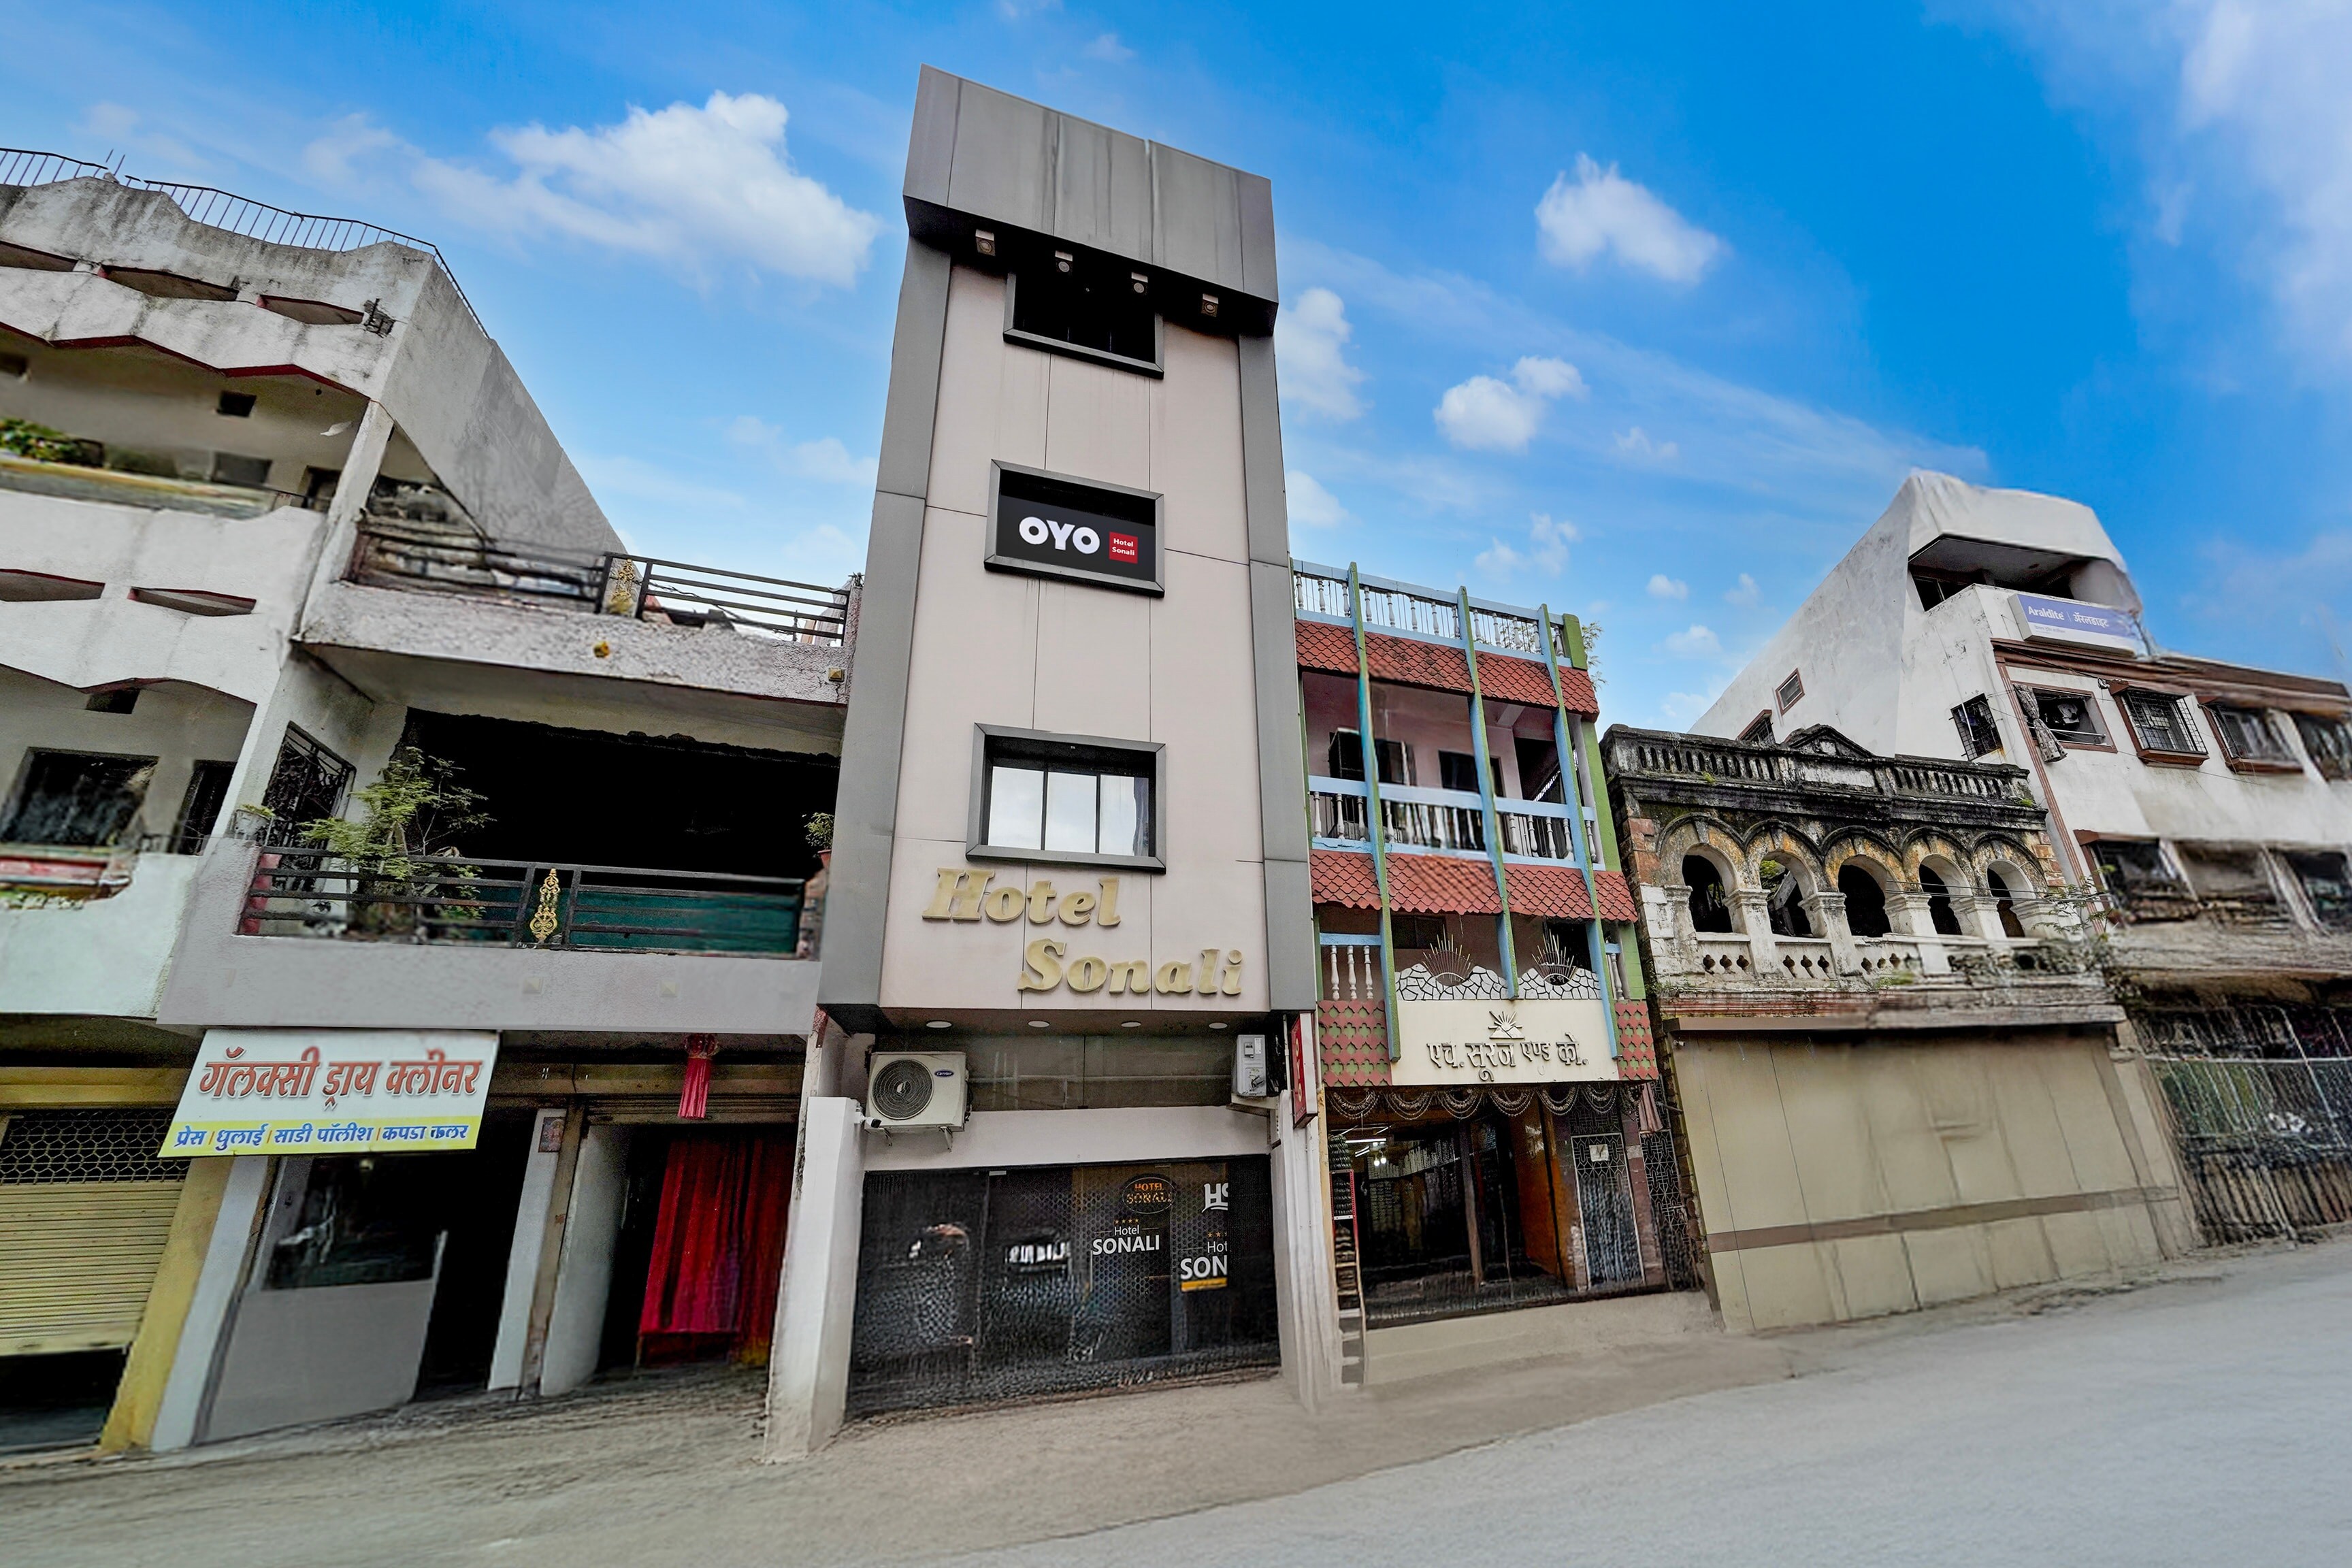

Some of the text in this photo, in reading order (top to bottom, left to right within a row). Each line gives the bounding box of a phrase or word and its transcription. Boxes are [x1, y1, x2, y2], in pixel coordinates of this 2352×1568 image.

[1019, 517, 1100, 554] OYO
[1113, 538, 1134, 547] Hotel
[1111, 546, 1135, 556] Sonali
[2028, 606, 2065, 621] Araldite
[921, 867, 1122, 926] Hotel
[1017, 938, 1244, 996] Sonali
[1465, 1042, 1516, 1082] सूरज
[174, 1125, 207, 1147] प्रेस
[215, 1123, 269, 1151] धुलाई
[274, 1123, 313, 1144] साडी
[1114, 1224, 1139, 1235] Hotel
[1092, 1235, 1160, 1256] SONALI
